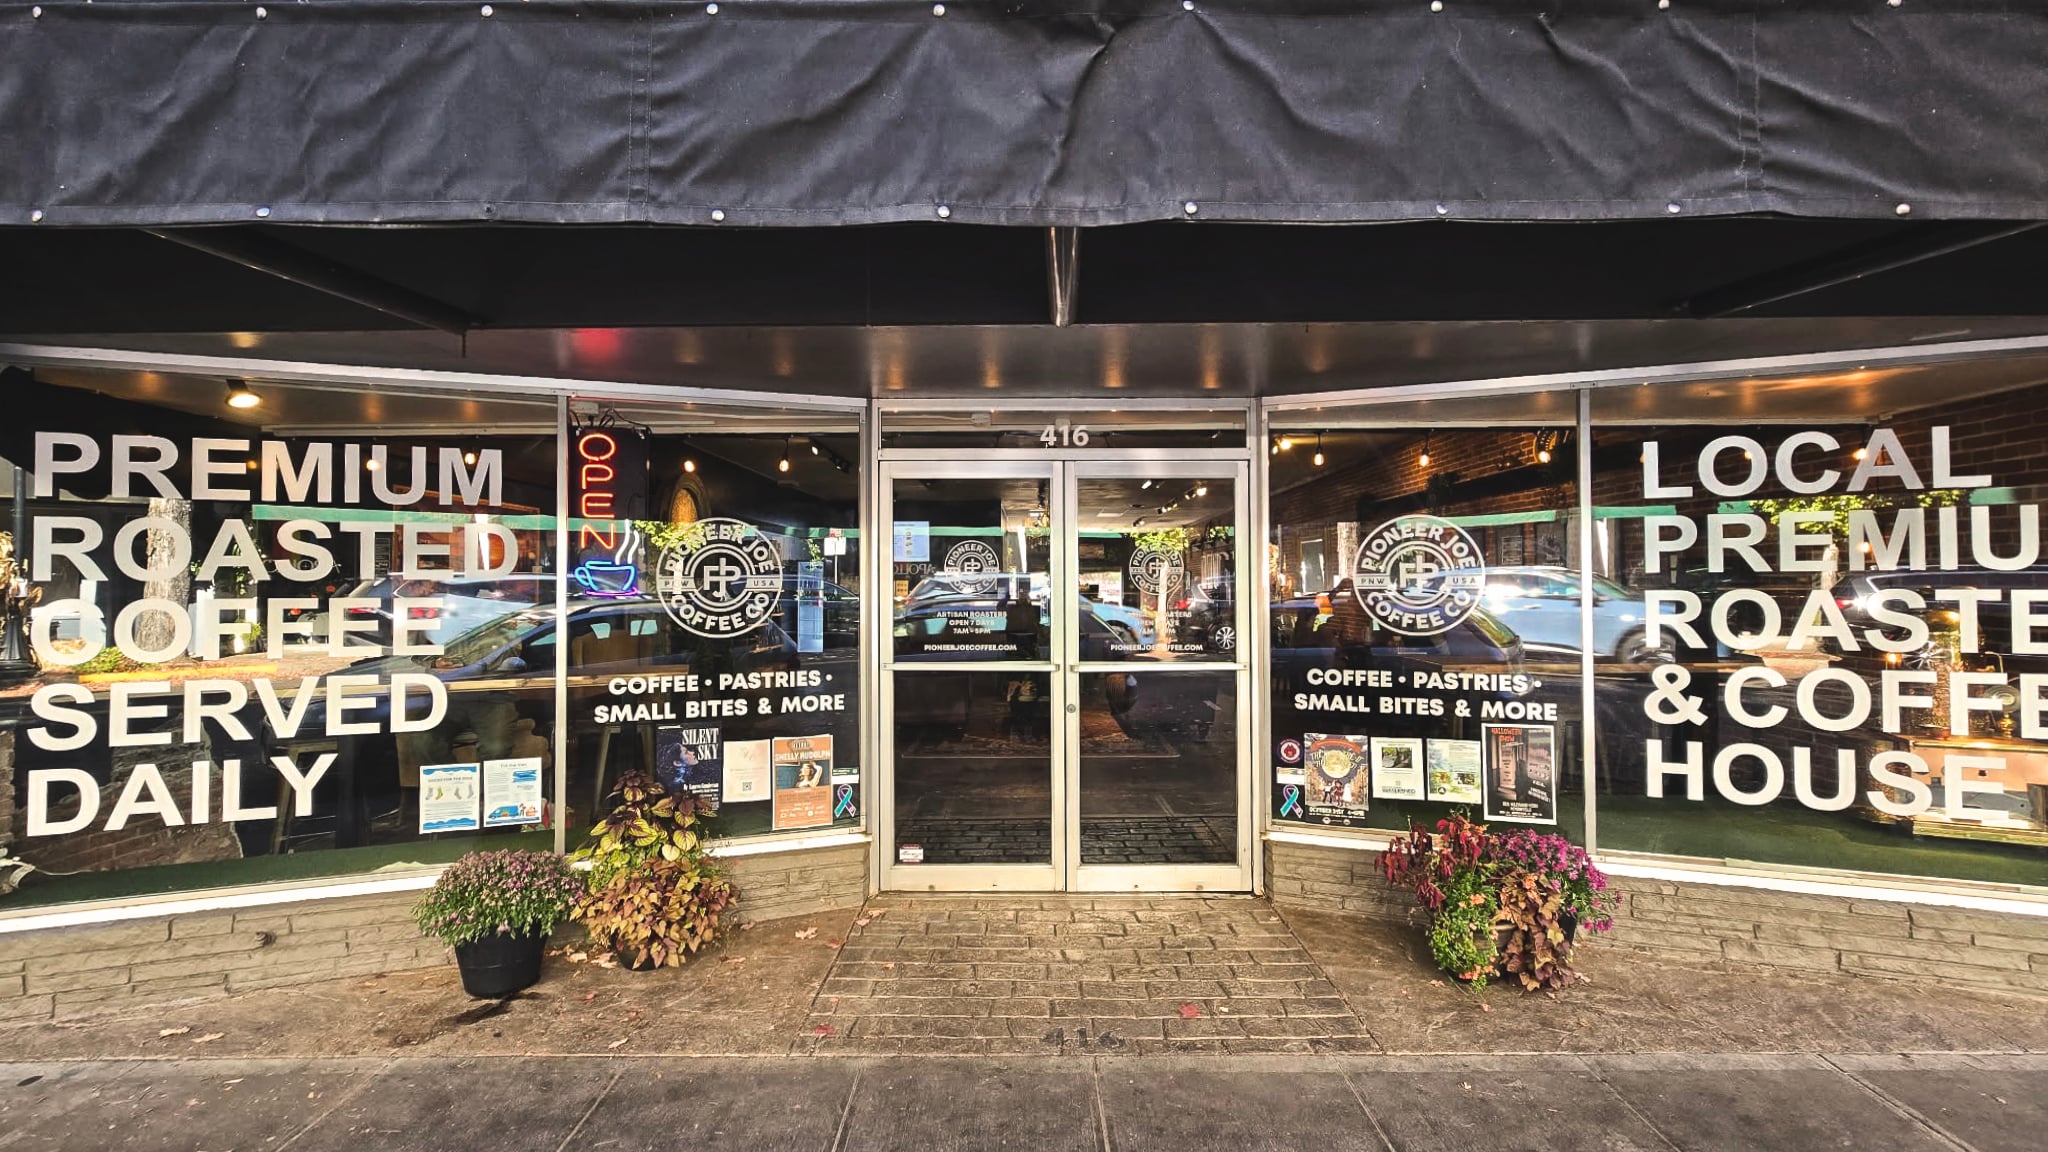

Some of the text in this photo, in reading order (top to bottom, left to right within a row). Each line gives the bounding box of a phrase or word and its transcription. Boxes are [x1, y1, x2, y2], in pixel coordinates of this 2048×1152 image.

[1039, 425, 1089, 446] 416
[34, 431, 503, 507] PREMIUM
[1642, 425, 1993, 499] LOCAL
[578, 433, 616, 550] OPEN
[31, 515, 519, 583] ROASTED
[742, 539, 775, 573] JOE
[947, 543, 996, 566] PIONEER JOE
[1361, 522, 1444, 571] PIONEER
[1440, 535, 1476, 568] JOE
[670, 593, 770, 630] COFFEE CO
[1367, 590, 1470, 629] COFFEE CO
[29, 597, 445, 666] COFFEE
[608, 670, 821, 696] COFFEE PASTRIES
[1306, 668, 1528, 691] COFFEE PASTRIES
[1643, 663, 1708, 726] &
[27, 673, 449, 752] SERVED
[594, 694, 845, 723] SMALL BITES & MORE
[1294, 693, 1558, 721] SMALL BITES & MORE
[682, 728, 719, 745] SILENT
[697, 744, 719, 760] SKY
[26, 753, 338, 837] DAILY
[1645, 738, 2010, 822] HOUSE
